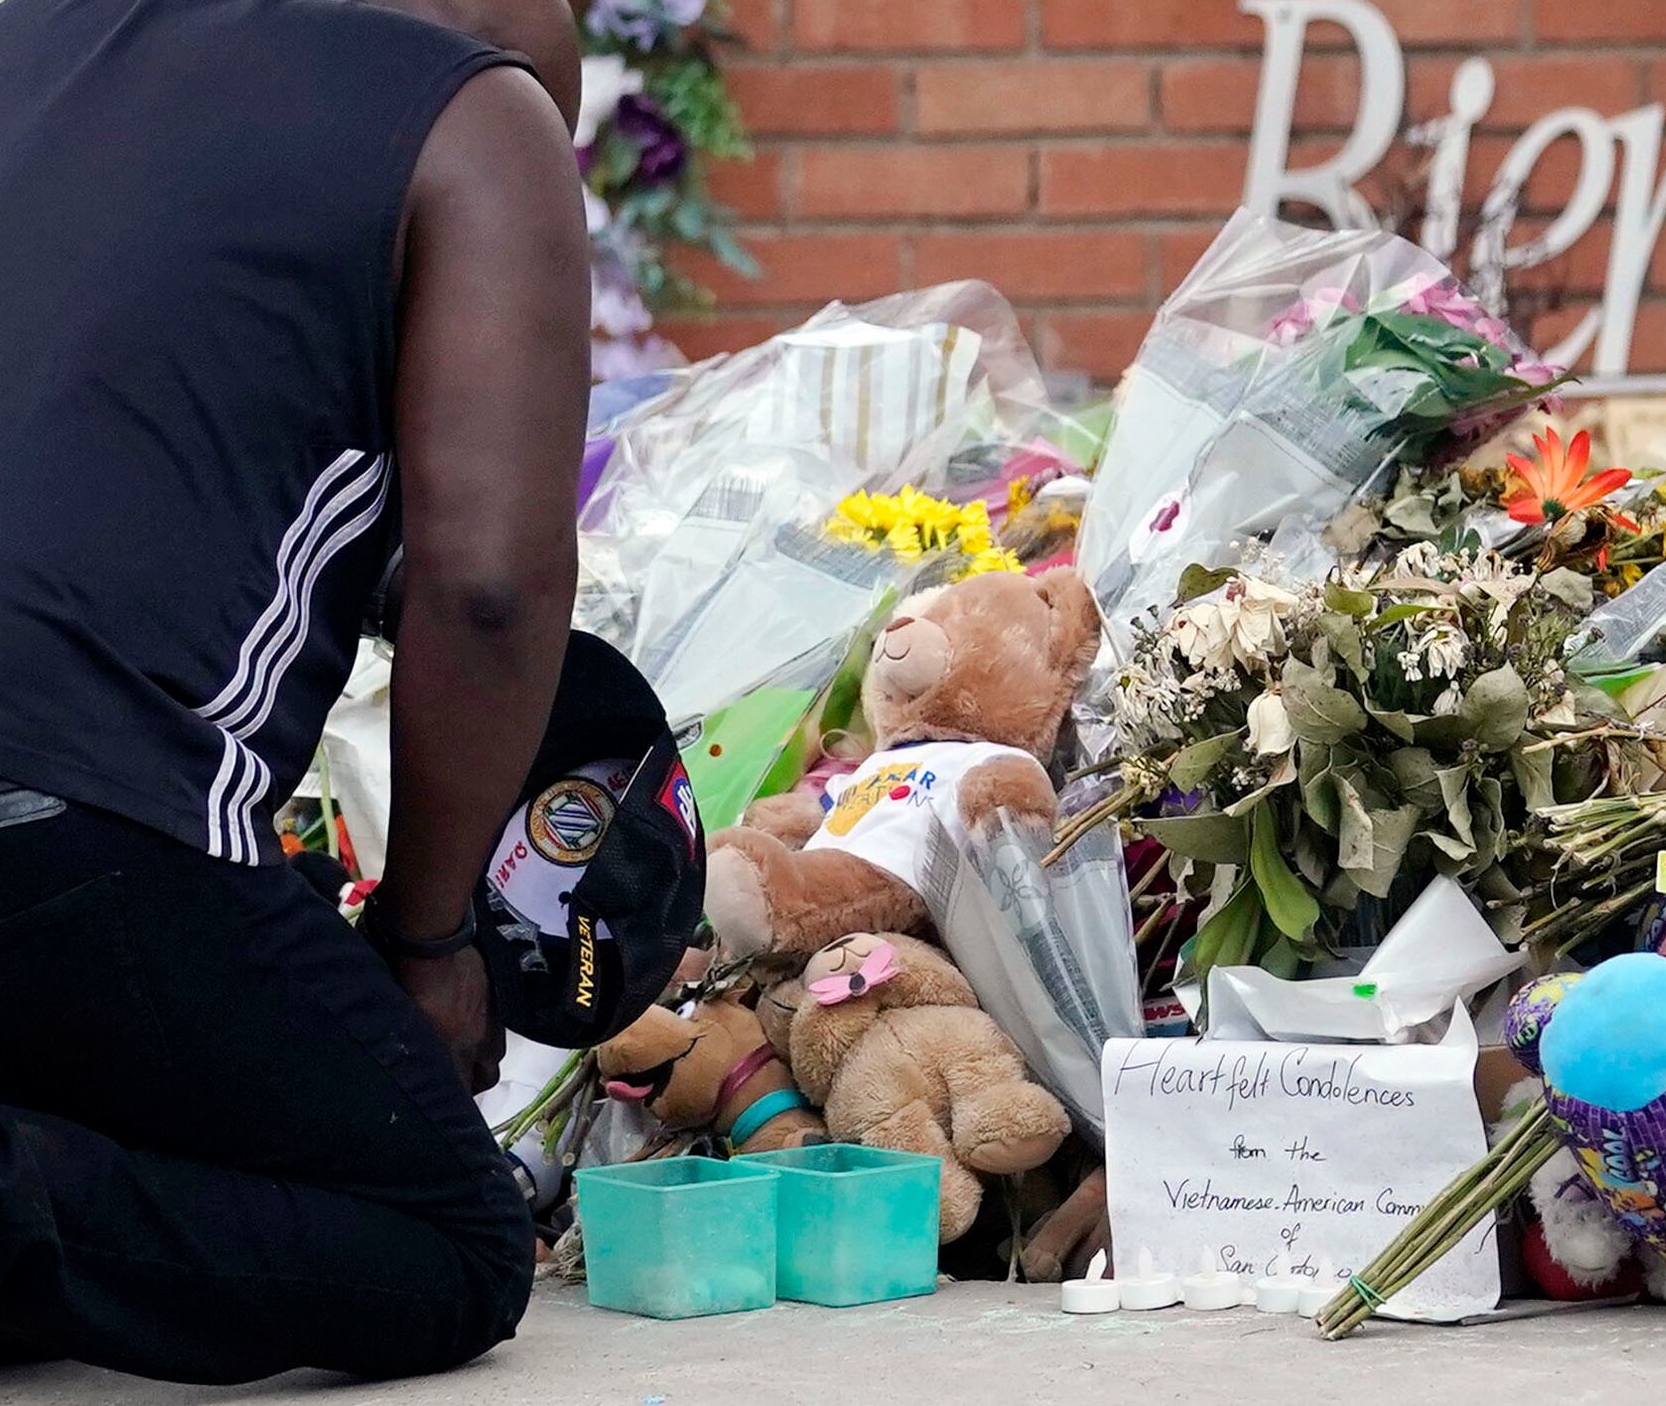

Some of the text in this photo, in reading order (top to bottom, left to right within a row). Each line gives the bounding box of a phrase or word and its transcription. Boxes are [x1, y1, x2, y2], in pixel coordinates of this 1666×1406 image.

[575, 914, 596, 1009] VETERAN
[1113, 1040, 1415, 1112] Heartfelt Condolences
[1228, 1134, 1327, 1162] from the
[1280, 1222, 1302, 1251] of
[1215, 1244, 1255, 1275] San
